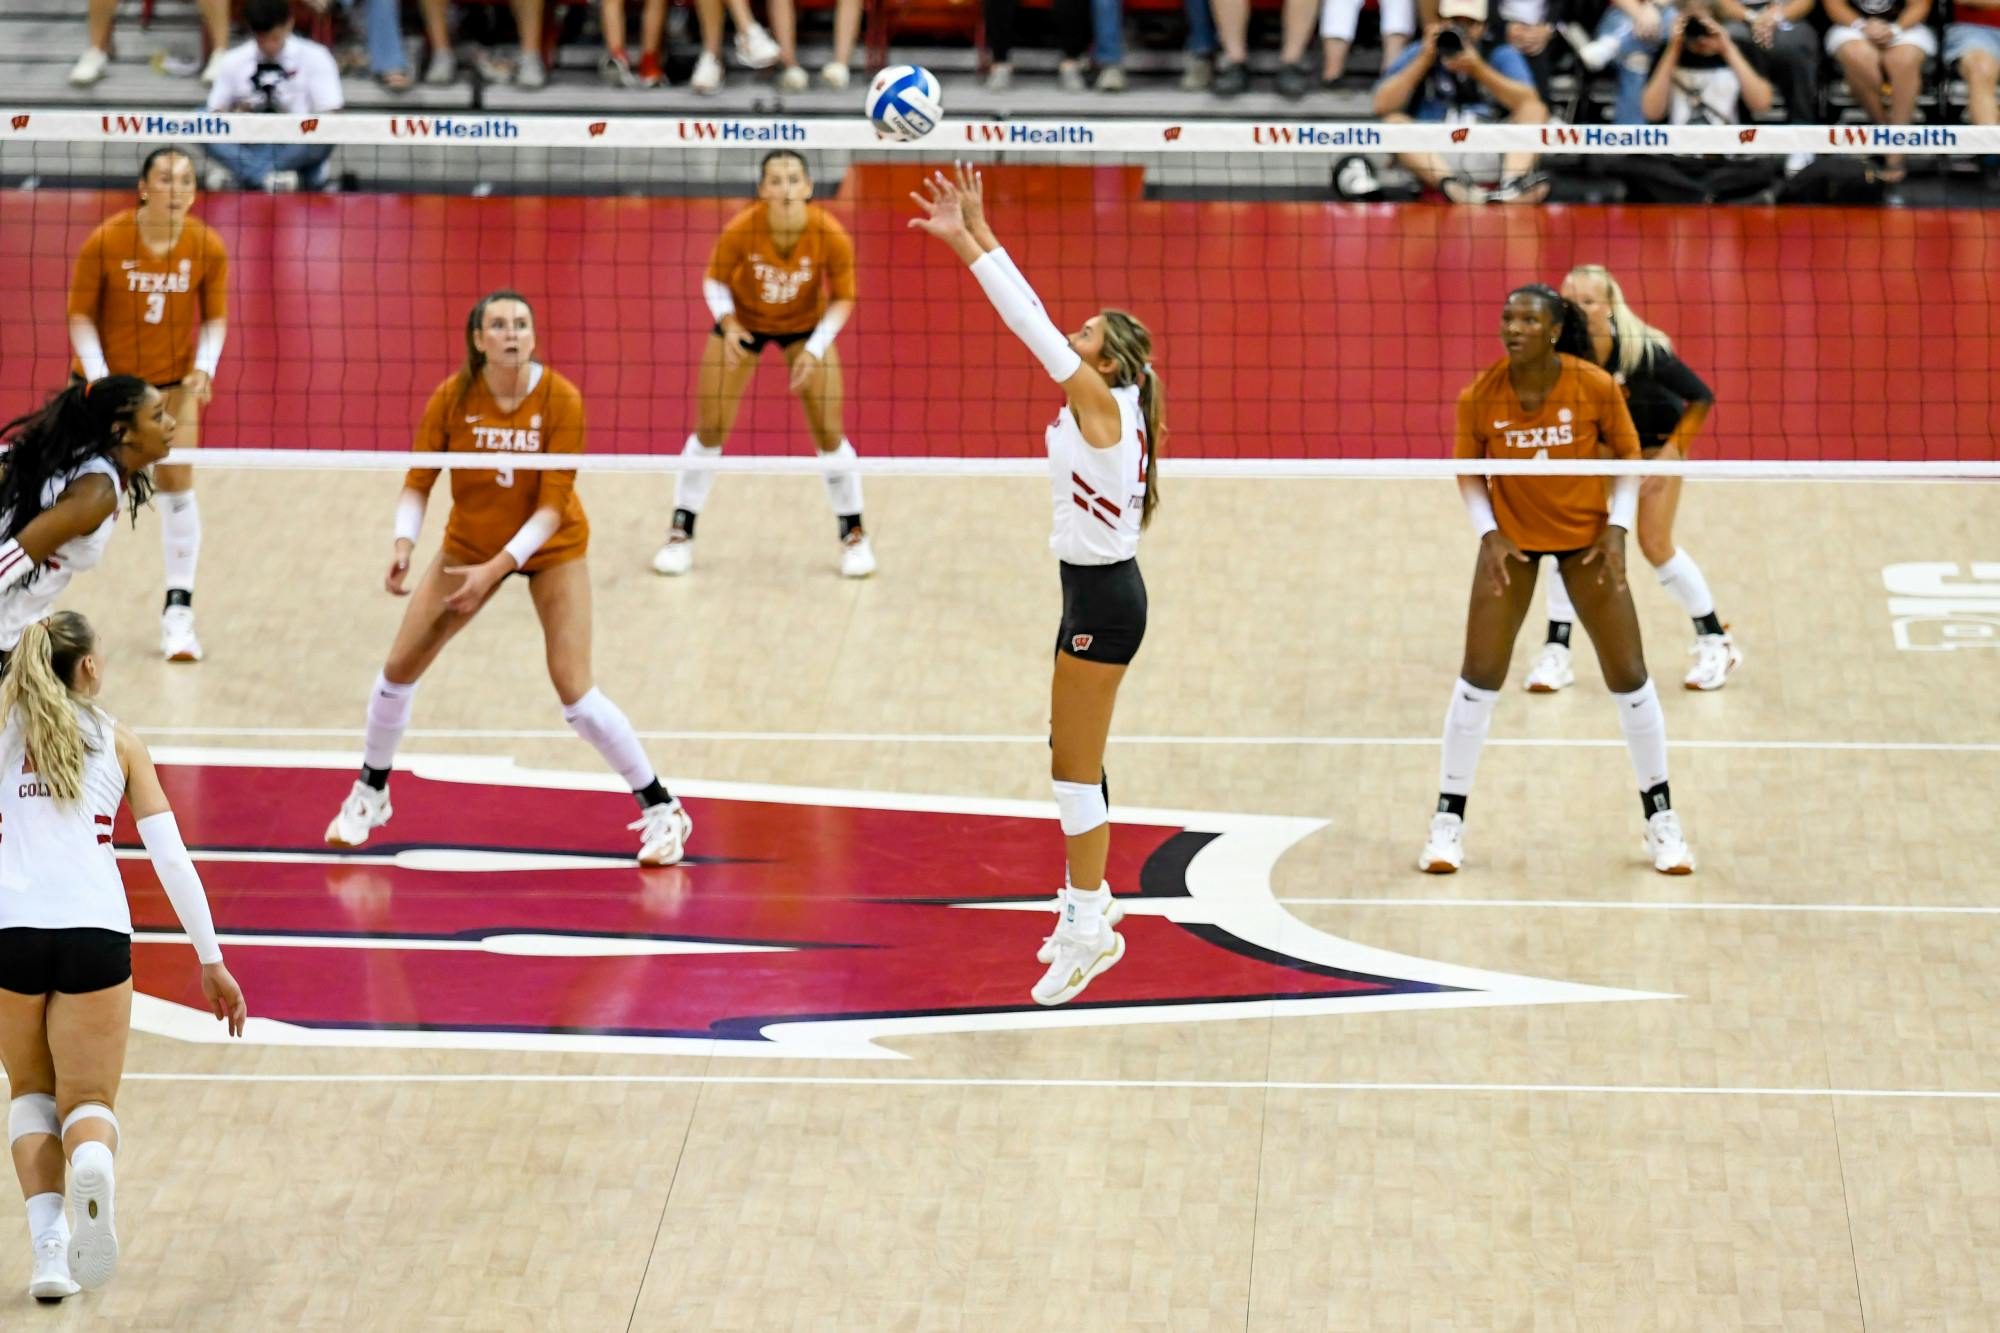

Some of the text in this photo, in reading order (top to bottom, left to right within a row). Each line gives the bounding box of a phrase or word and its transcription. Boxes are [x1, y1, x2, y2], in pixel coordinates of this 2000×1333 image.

[127, 271, 189, 293] TEXAS
[143, 292, 166, 325] 3
[472, 426, 540, 451] TEXAS
[1504, 424, 1573, 449] TEXAS
